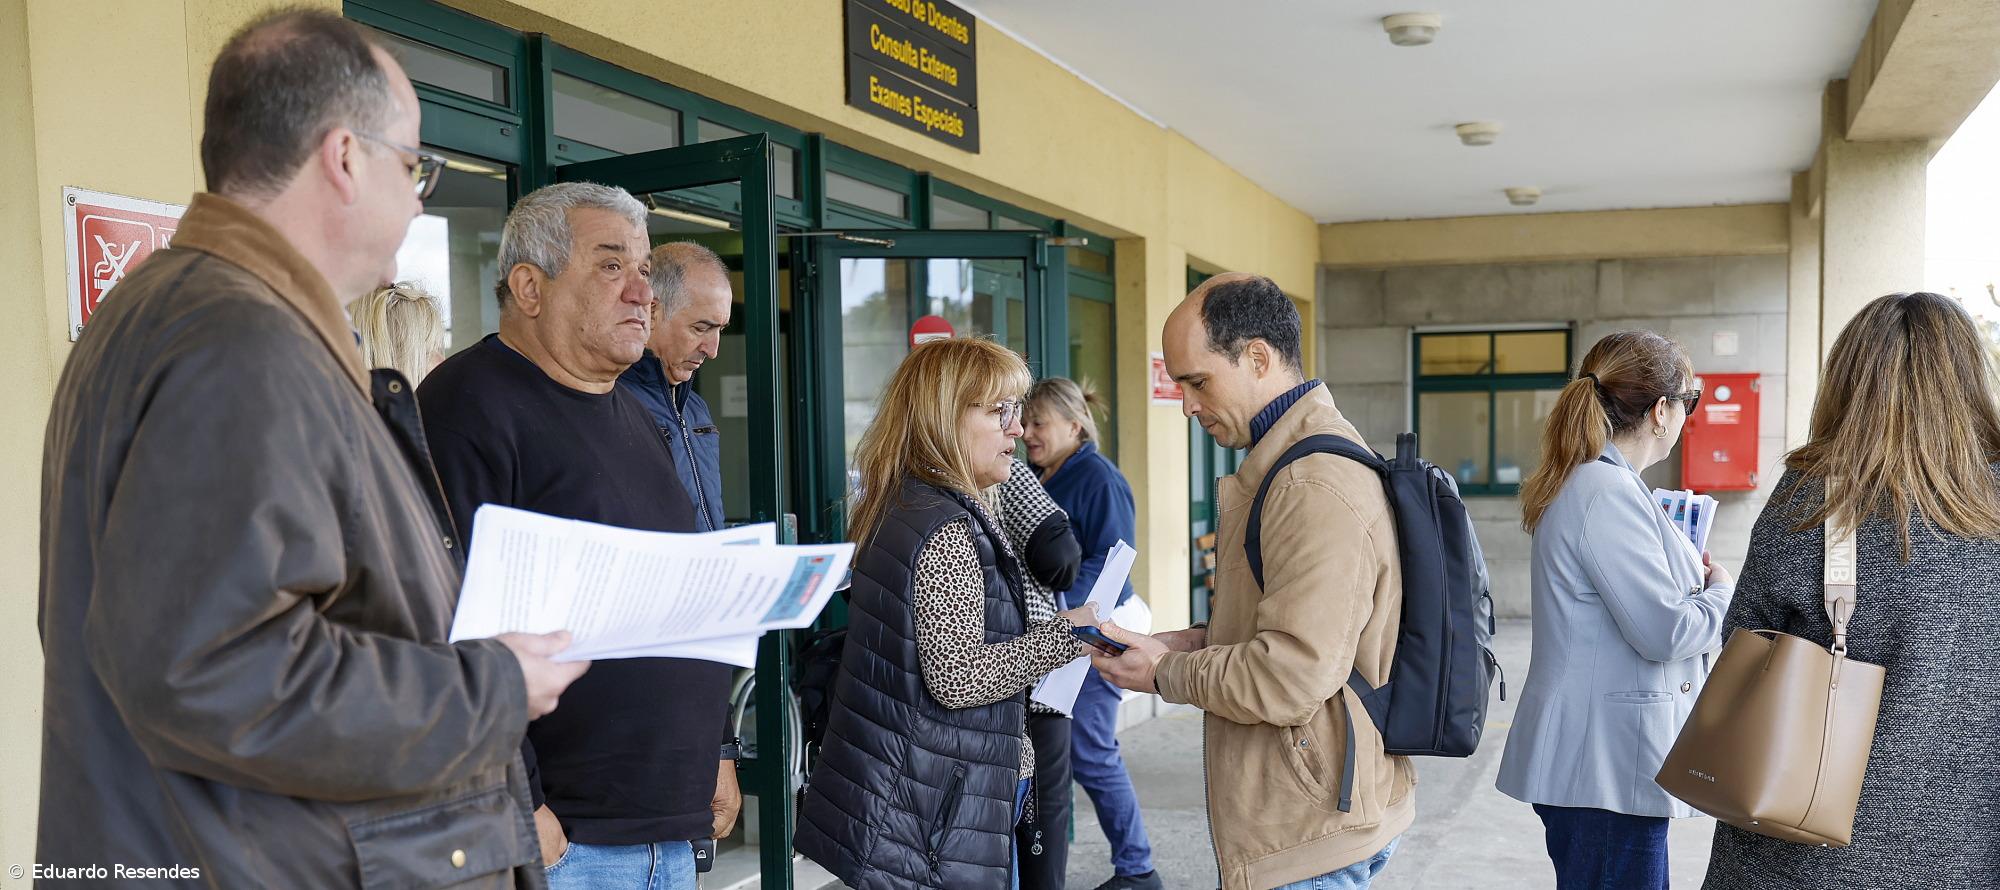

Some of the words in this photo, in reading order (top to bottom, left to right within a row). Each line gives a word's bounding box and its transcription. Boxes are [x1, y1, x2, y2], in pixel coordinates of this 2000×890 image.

[870, 23, 919, 69] Consulta
[920, 47, 958, 87] Externa
[927, 2, 969, 45] Doentes
[869, 75, 912, 117] Exames
[913, 96, 964, 138] Especiais
